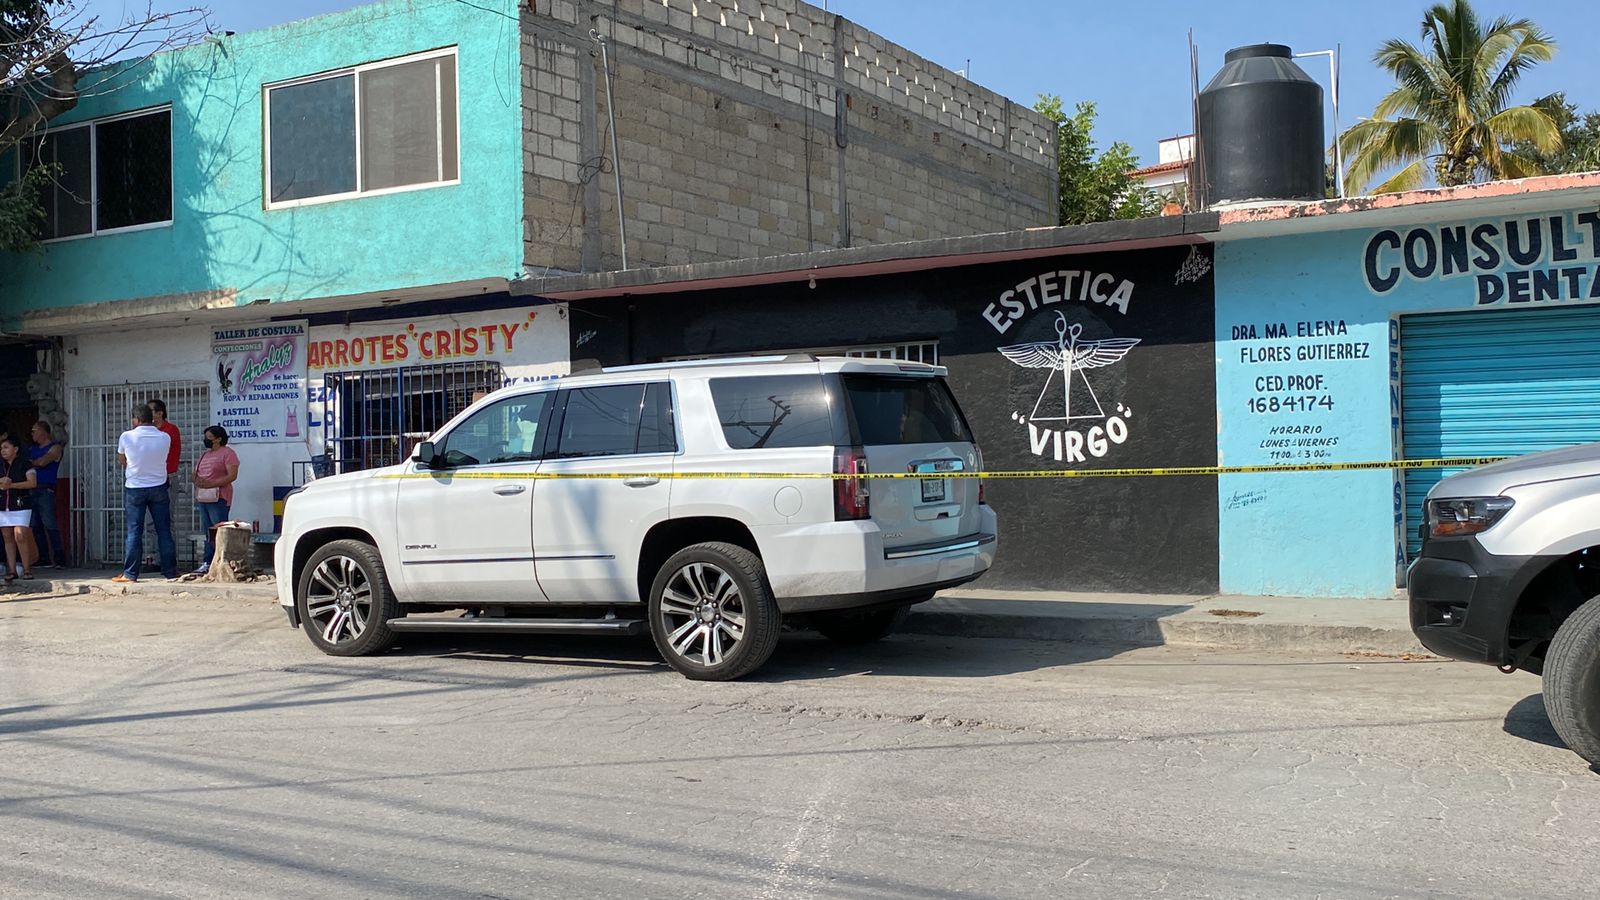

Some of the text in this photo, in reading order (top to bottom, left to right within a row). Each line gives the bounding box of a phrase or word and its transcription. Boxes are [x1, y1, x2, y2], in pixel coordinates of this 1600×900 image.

[982, 270, 1135, 334] ESTETICA
[214, 324, 304, 340] TALLER DE COSTURA
[1231, 320, 1347, 340] DRA. MA. ELENA
[214, 343, 262, 353] CONFECCIONES
[1241, 342, 1369, 363] FLORES GUTIERREZ
[253, 383, 271, 391] TODO
[272, 382, 288, 390] TIPO
[223, 394, 241, 402] ROPA
[248, 392, 299, 401] REPARACIONES
[1247, 395, 1334, 413] 1684174
[222, 407, 260, 416] BASTILLA
[222, 419, 251, 427] CIERRE
[227, 429, 278, 439] JUSTES, ETC.
[1269, 425, 1322, 435] HORARIO
[1260, 438, 1290, 449] LUNES
[1297, 436, 1339, 448] VIERNES
